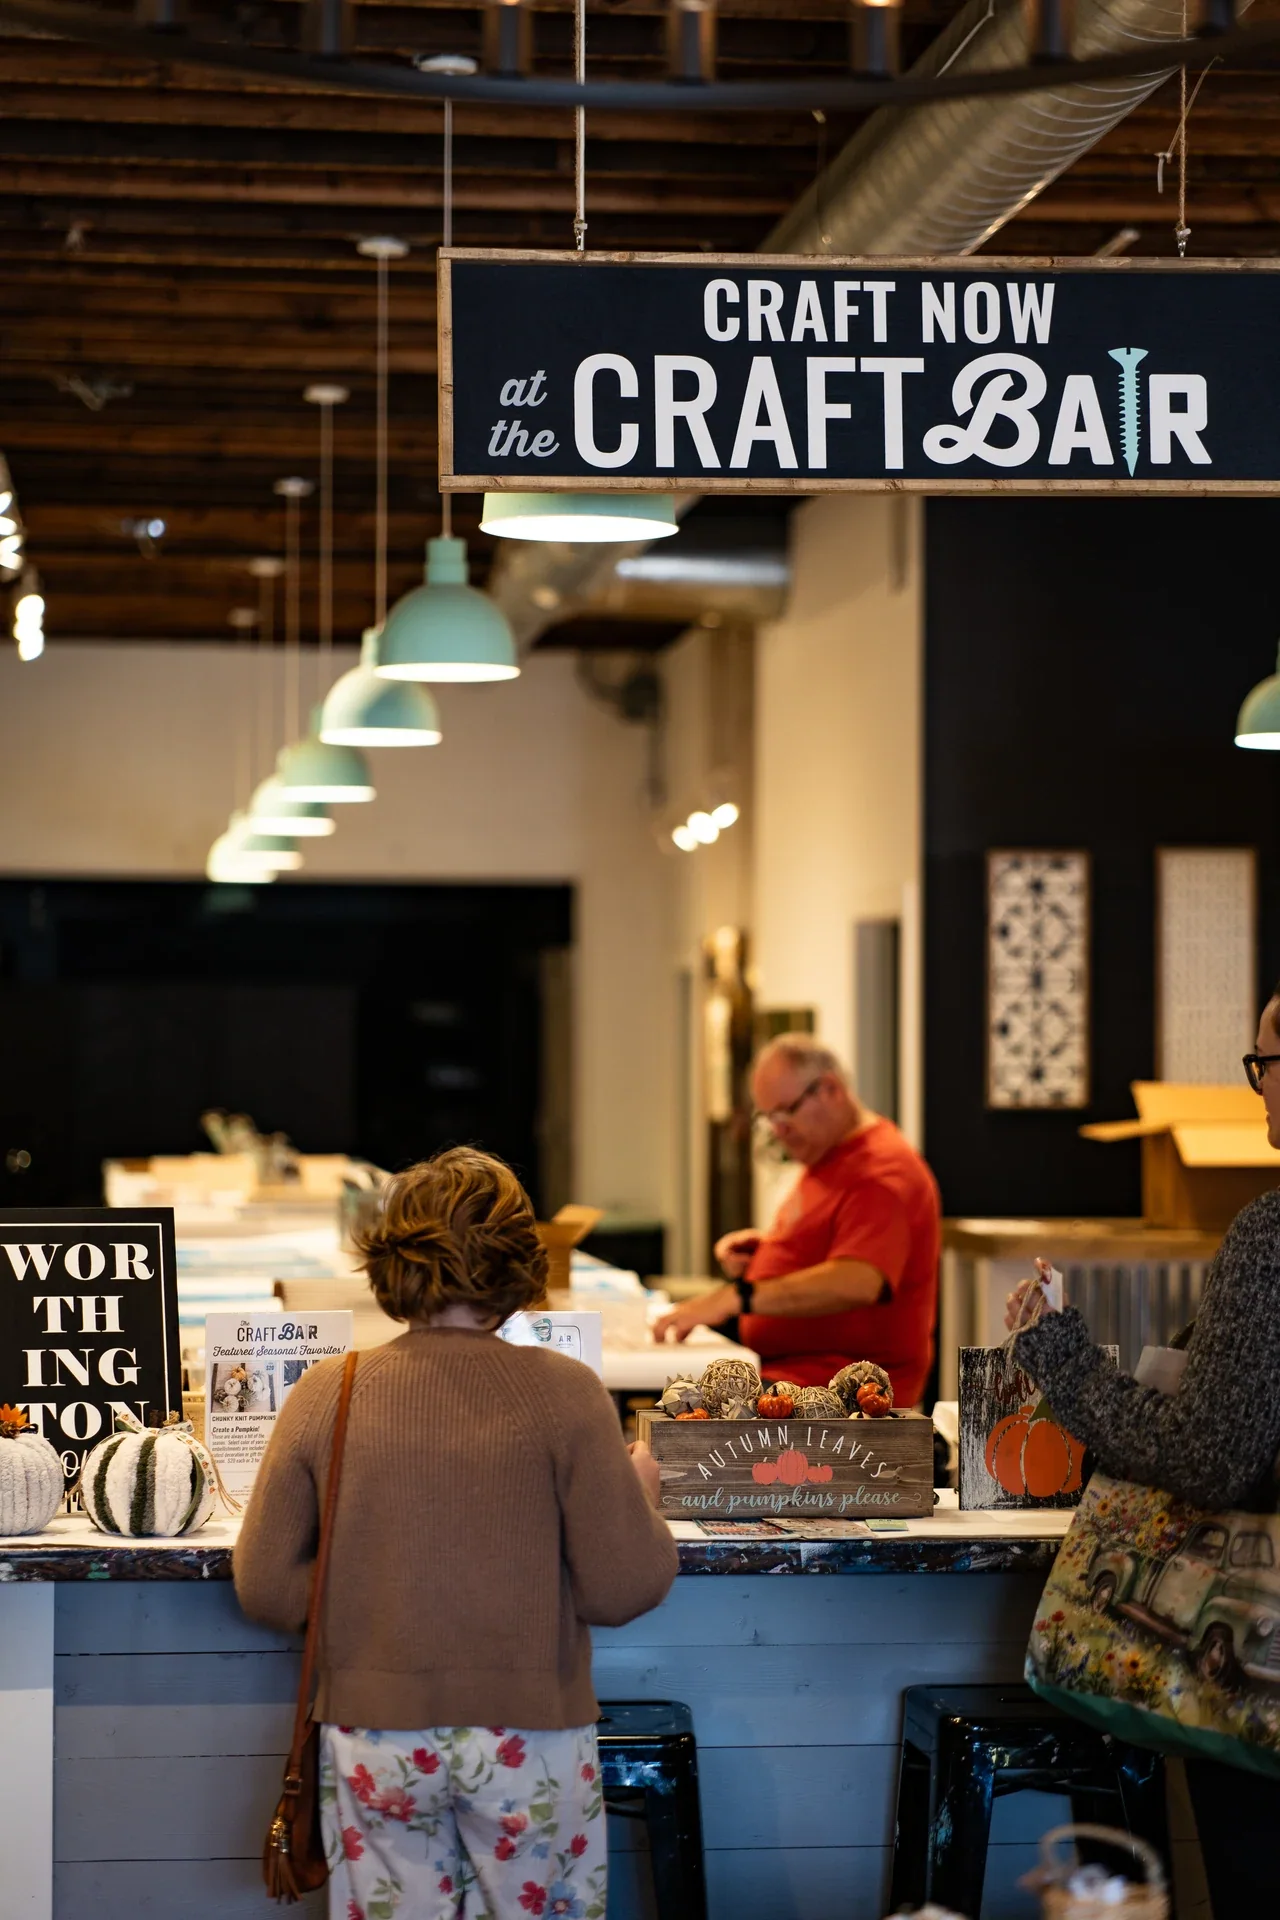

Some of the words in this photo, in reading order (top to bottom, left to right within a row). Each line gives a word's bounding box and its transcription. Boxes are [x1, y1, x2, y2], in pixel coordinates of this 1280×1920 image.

[703, 279, 897, 344] CRAFT
[921, 281, 1056, 345] NOW
[499, 370, 548, 408] at
[573, 353, 924, 469] CRAFT
[488, 418, 560, 459] the
[0, 1243, 155, 1281] WOR
[33, 1295, 125, 1333] TH
[213, 1346, 255, 1357] Featured
[256, 1345, 298, 1357] Seasonal
[299, 1345, 346, 1356] Favorites!
[237, 1327, 277, 1342] CRAFT
[22, 1347, 142, 1387] ING
[15, 1401, 150, 1441] TON
[697, 1424, 789, 1480] AUTUMN
[806, 1426, 887, 1478] LEAVES
[681, 1487, 724, 1509] and
[725, 1485, 837, 1515] pumpkins
[839, 1484, 903, 1513] please
